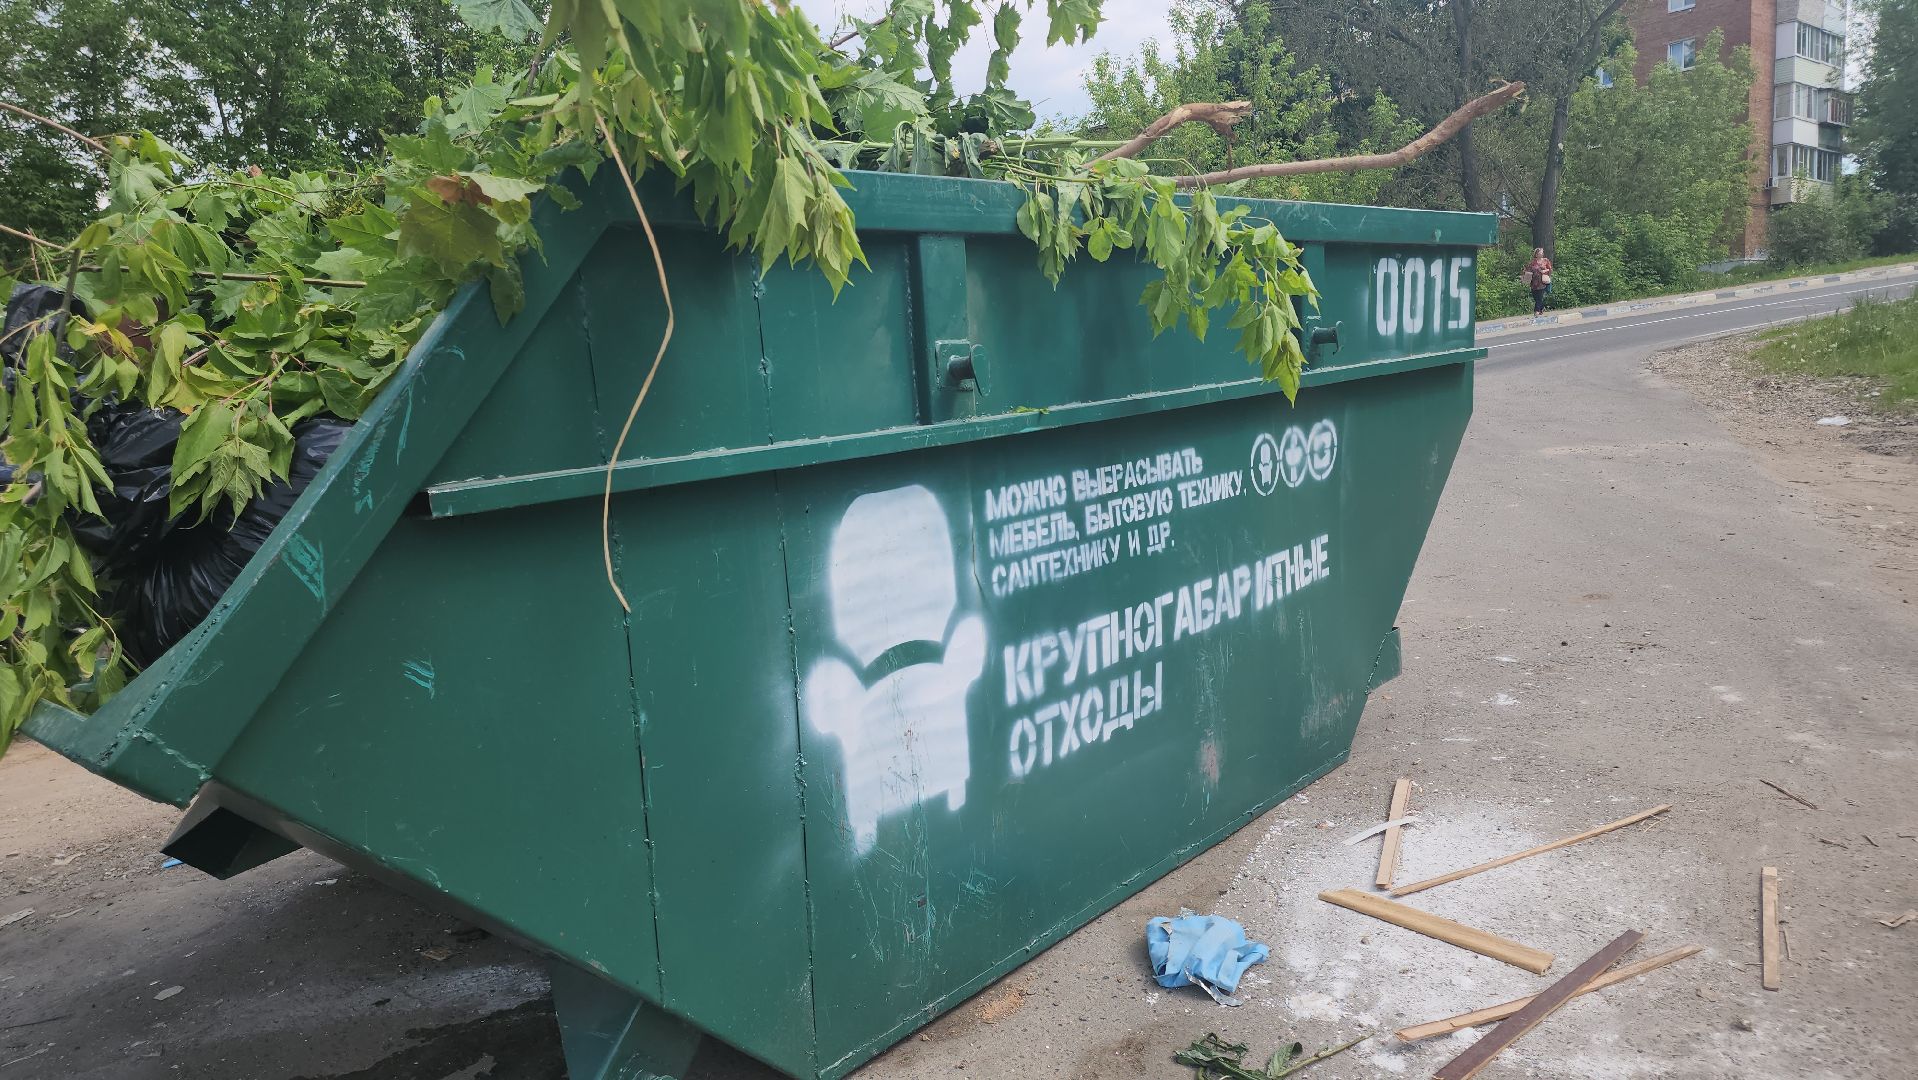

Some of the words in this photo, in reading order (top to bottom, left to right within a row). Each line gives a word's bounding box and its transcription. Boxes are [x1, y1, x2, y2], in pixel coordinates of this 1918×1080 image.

[1376, 257, 1472, 336] 0015
[985, 475, 1067, 522] МОЖНО
[1072, 448, 1203, 499] ВЫБРАСЫВАТЬ
[989, 511, 1080, 560] МЕБЕЛЬ,
[1086, 482, 1173, 535] БЫТОВУЮ
[992, 533, 1121, 598] САНТЕХНИКУ
[1128, 530, 1141, 557] И
[1147, 521, 1175, 556] ДР.
[1010, 661, 1163, 778] ОТХОДЫ
